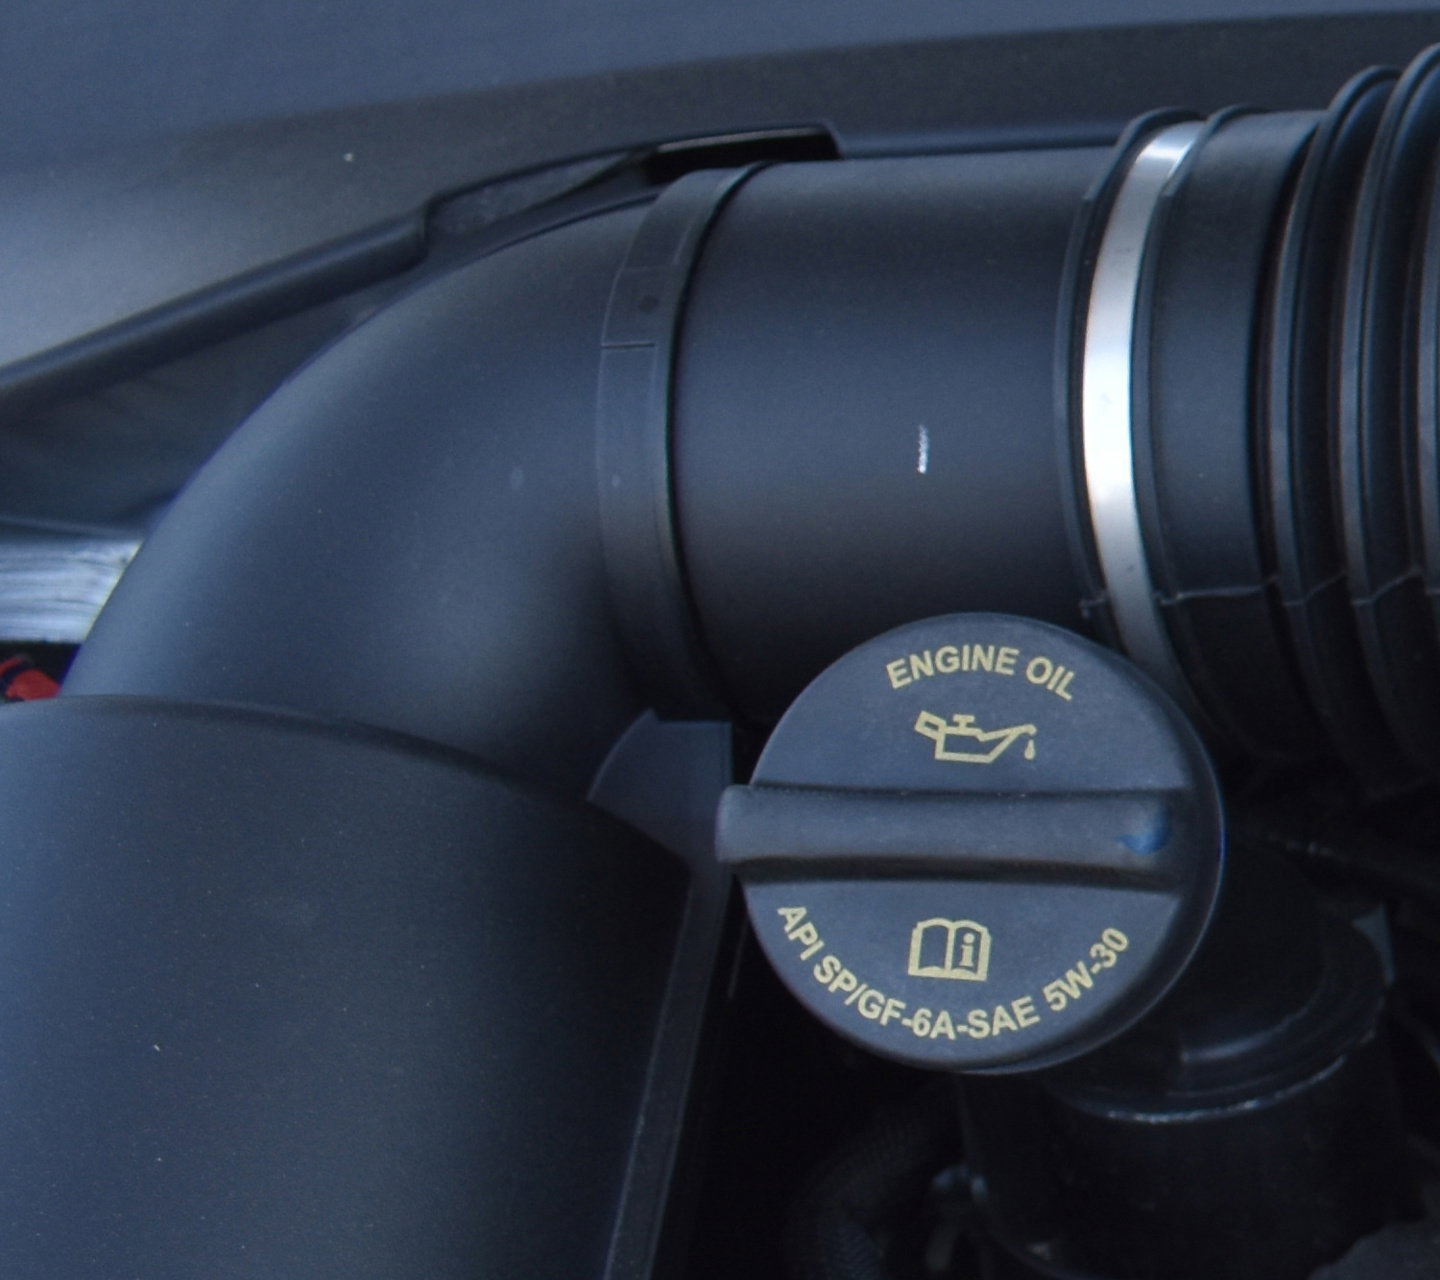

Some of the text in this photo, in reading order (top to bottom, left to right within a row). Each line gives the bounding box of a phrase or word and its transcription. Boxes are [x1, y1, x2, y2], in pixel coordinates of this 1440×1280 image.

[885, 643, 1076, 702] ENGINE OIL
[776, 905, 1130, 1042] API SP/GF-6A-SAE 5W-30
